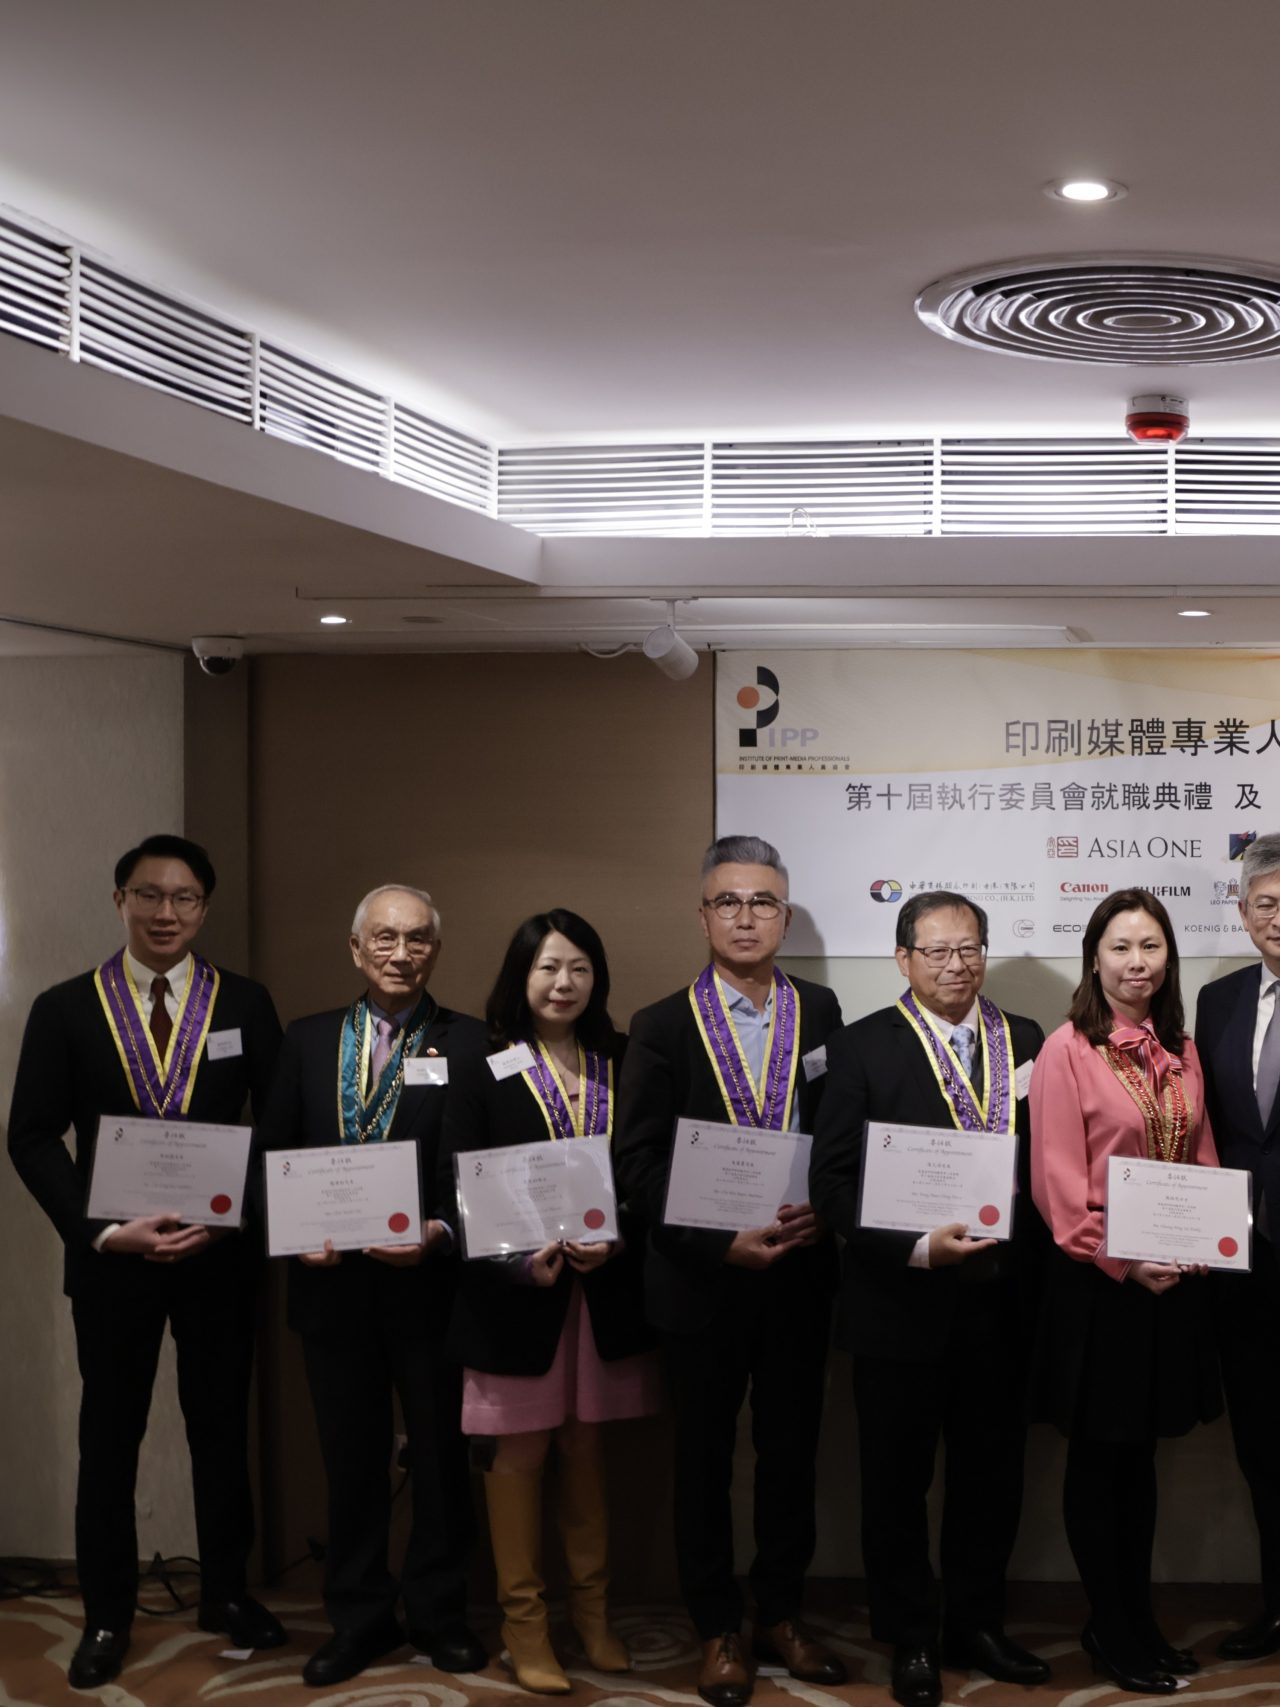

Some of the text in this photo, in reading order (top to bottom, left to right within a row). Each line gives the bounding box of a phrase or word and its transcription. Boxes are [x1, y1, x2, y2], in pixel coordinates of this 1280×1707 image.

[769, 727, 819, 747] IPP
[845, 782, 1213, 811] 第十屆執行委員會就職典禮
[1235, 782, 1262, 811] 及
[1087, 836, 1202, 858] ASIA ONE
[1060, 882, 1109, 893] Canon
[1184, 925, 1221, 933] KOENIG
